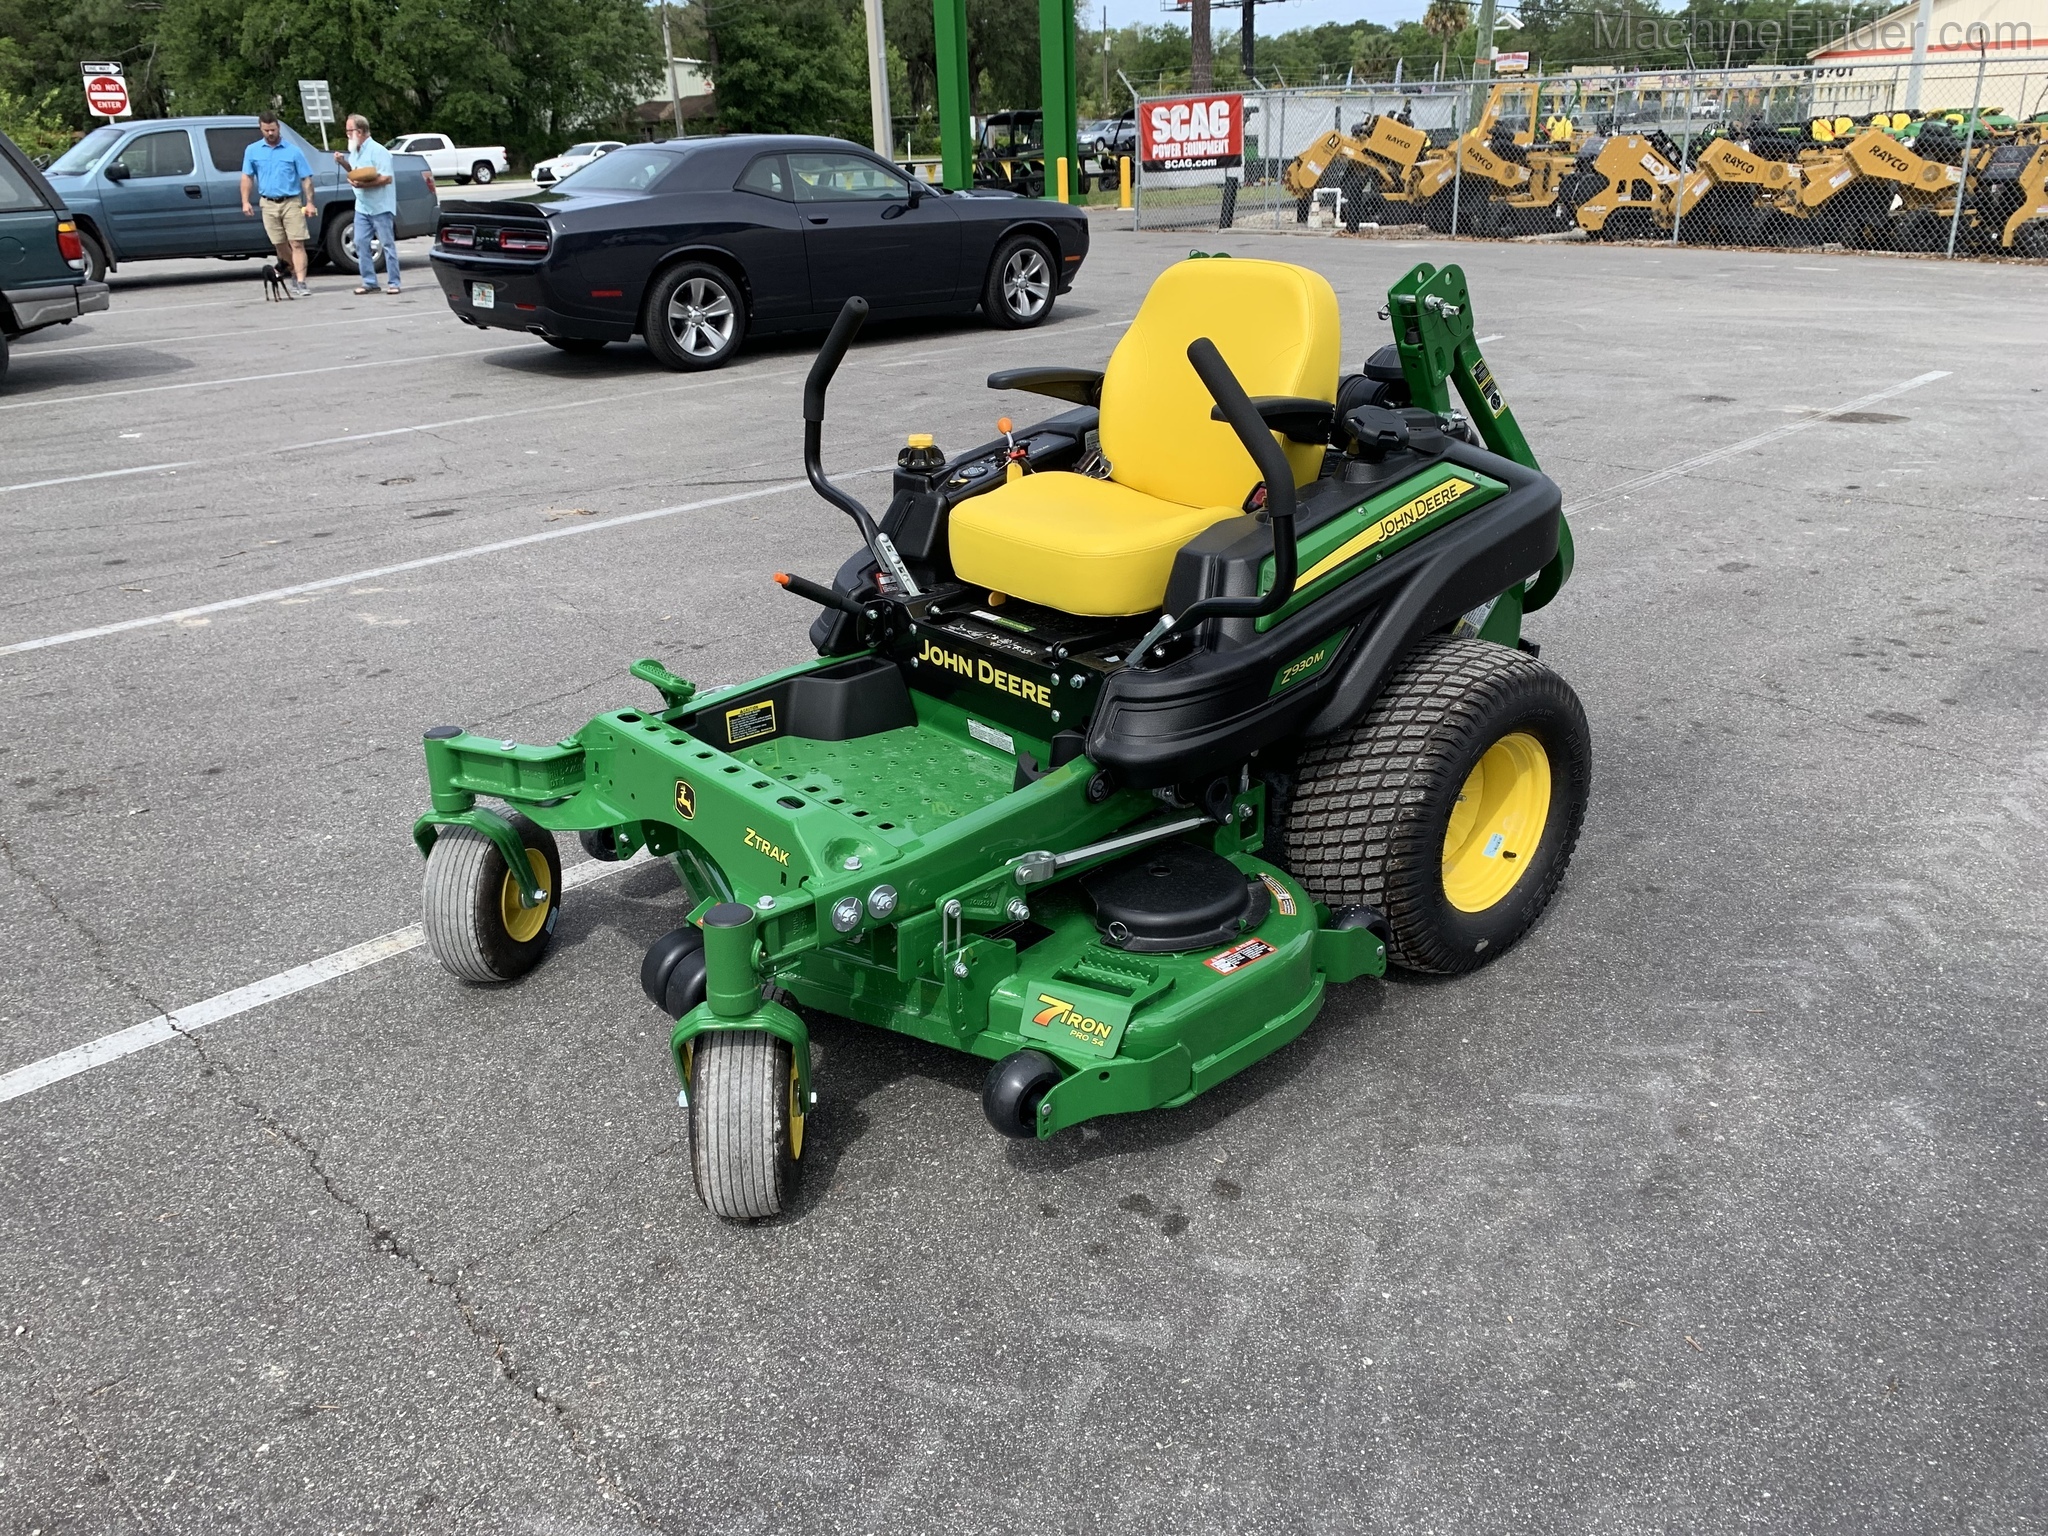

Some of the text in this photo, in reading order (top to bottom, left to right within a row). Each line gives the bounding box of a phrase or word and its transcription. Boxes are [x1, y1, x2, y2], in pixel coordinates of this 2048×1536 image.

[91, 83, 102, 91] DO
[97, 101, 121, 109] ENTER
[1151, 100, 1230, 143] SCAG
[1152, 138, 1230, 159] POWER EQUIPMENT
[1385, 133, 1411, 149] RAYCO
[1164, 159, 1217, 169] SCAG.com
[1466, 147, 1493, 171] RAYCO
[1722, 152, 1755, 174] RAYCO
[1868, 144, 1909, 172] RAYCO
[1379, 484, 1459, 540] JOHN DEERE
[919, 639, 973, 678] JOHN
[978, 659, 1051, 708] DEERE
[1281, 649, 1325, 685] Z930M
[1069, 1029, 1104, 1047] PRO 54
